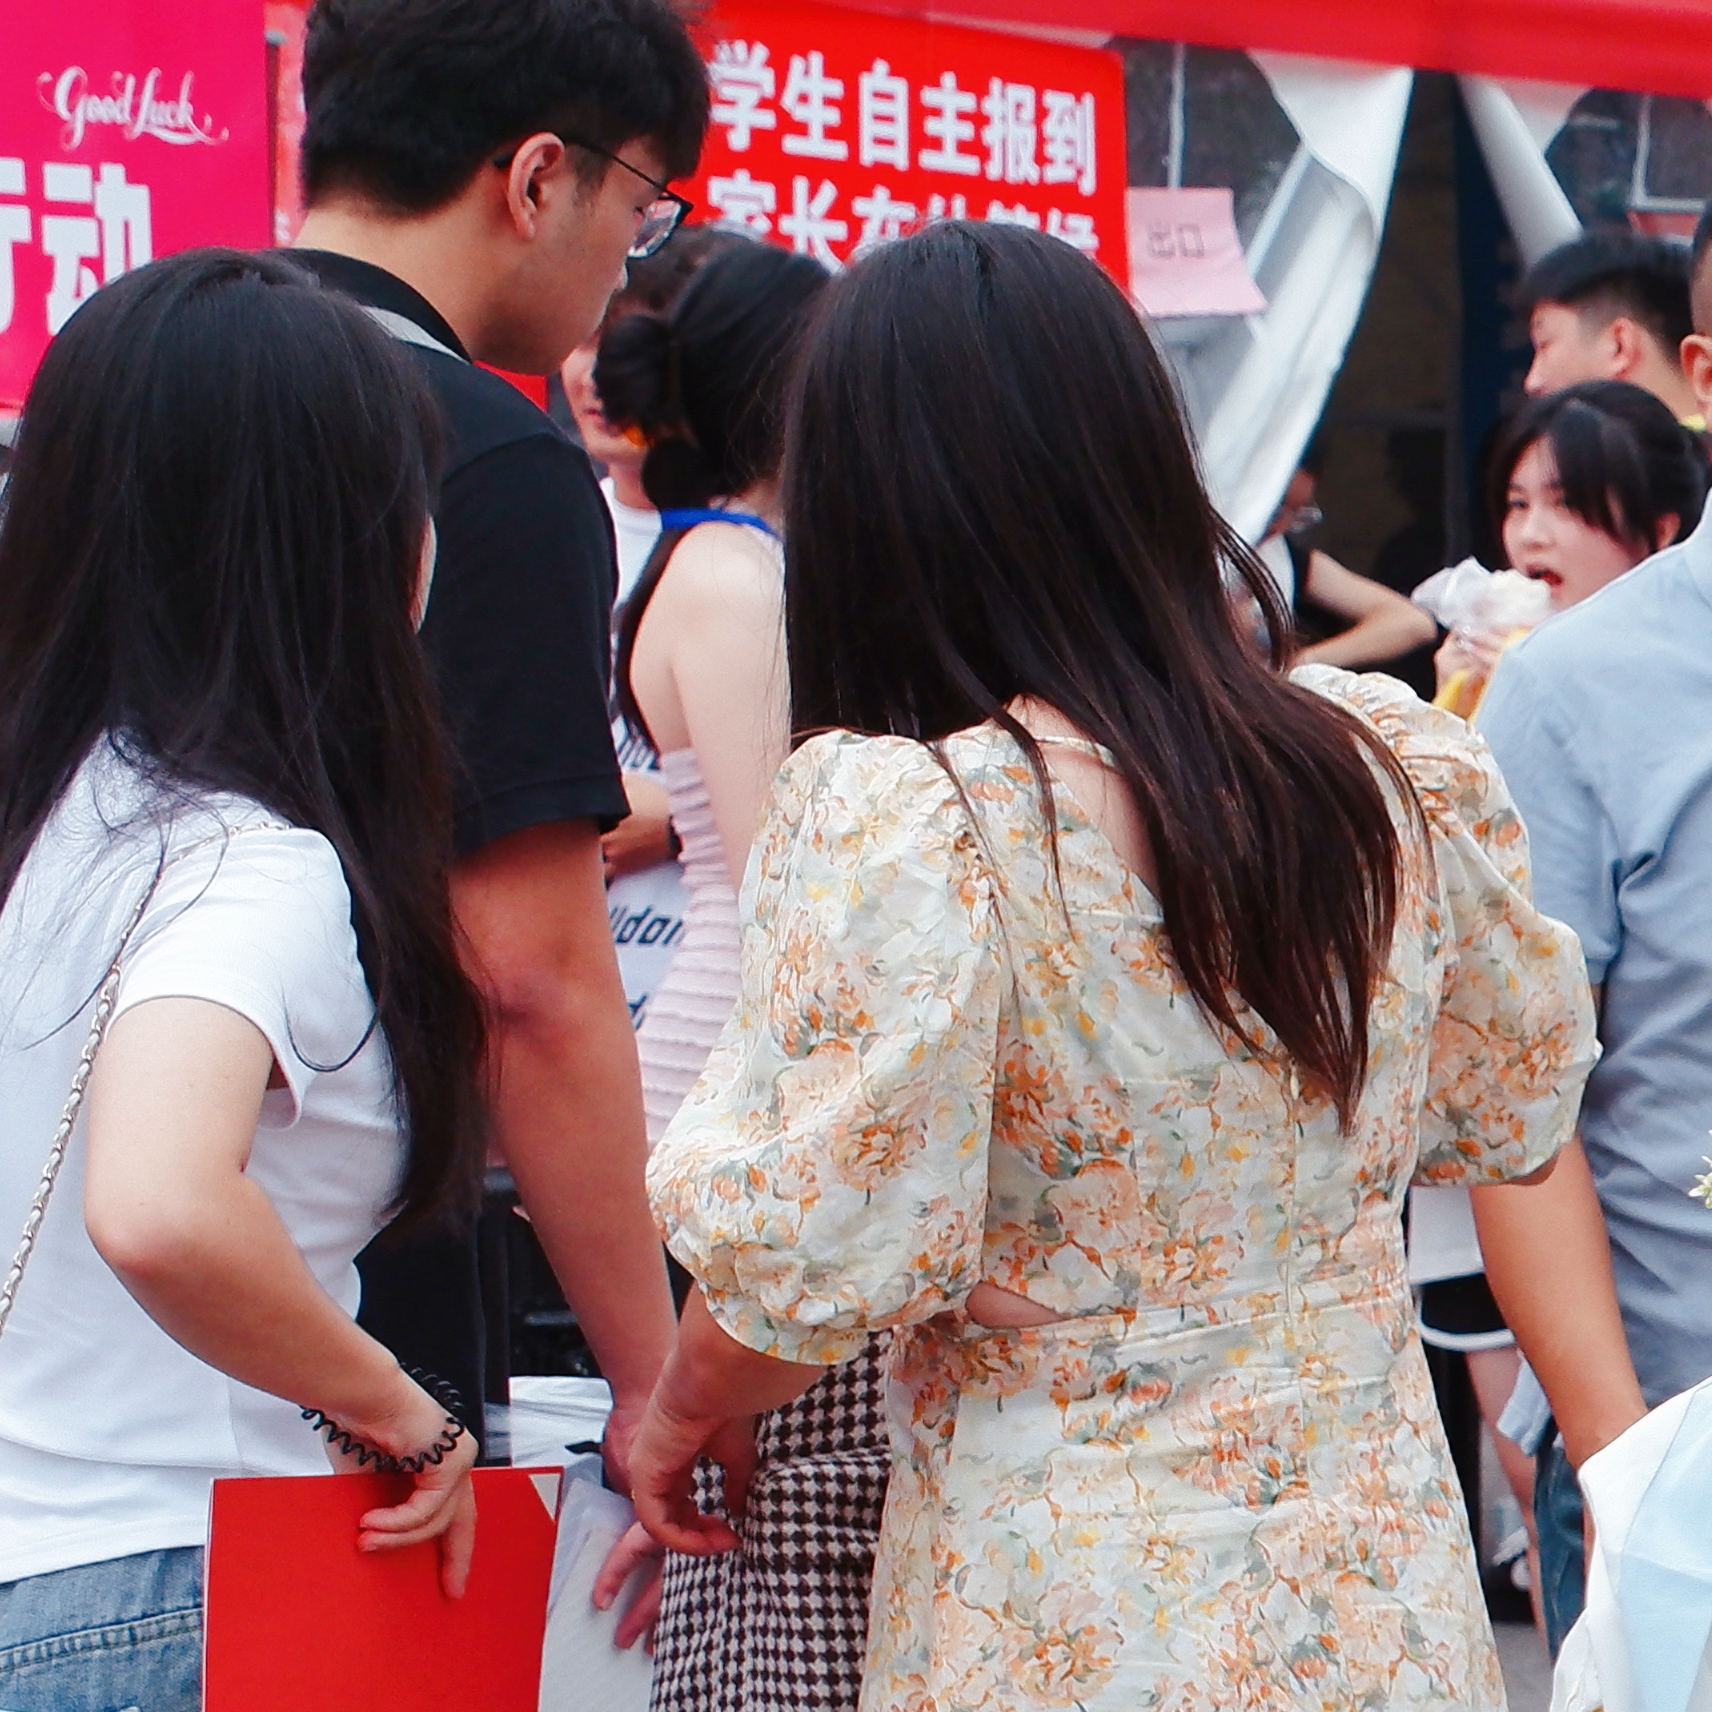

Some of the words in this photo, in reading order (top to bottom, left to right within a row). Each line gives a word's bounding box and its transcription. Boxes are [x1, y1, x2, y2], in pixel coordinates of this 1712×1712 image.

[37, 65, 136, 151] Good
[123, 66, 230, 146] Luck
[707, 39, 1098, 197] 学生自主报到
[1146, 221, 1205, 258] 出口
